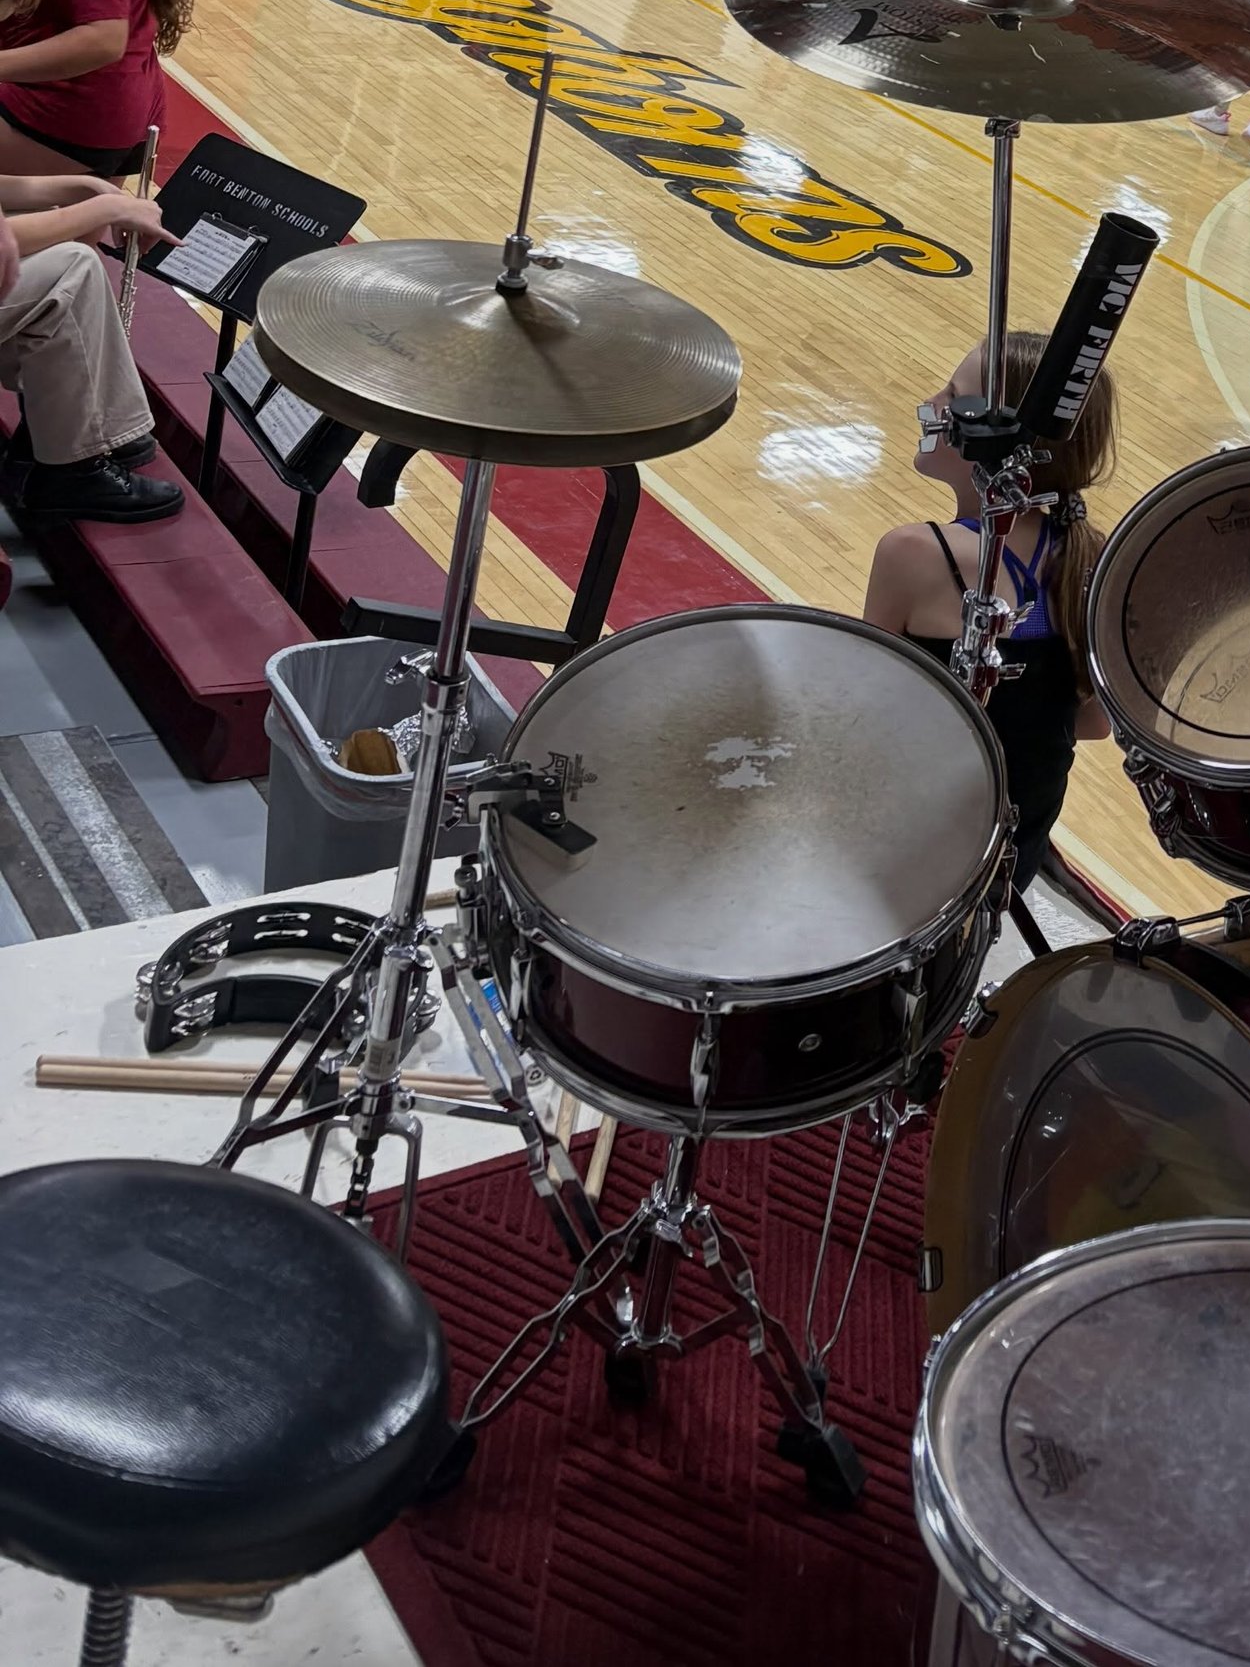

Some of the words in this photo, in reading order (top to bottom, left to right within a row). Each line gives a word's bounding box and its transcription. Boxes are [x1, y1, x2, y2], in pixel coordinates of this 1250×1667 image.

[190, 164, 226, 188] FORT
[222, 180, 271, 211] BENTON
[271, 203, 330, 239] SCHOOLS
[1099, 263, 1143, 315] VIC
[1053, 325, 1113, 420] FIRTH
